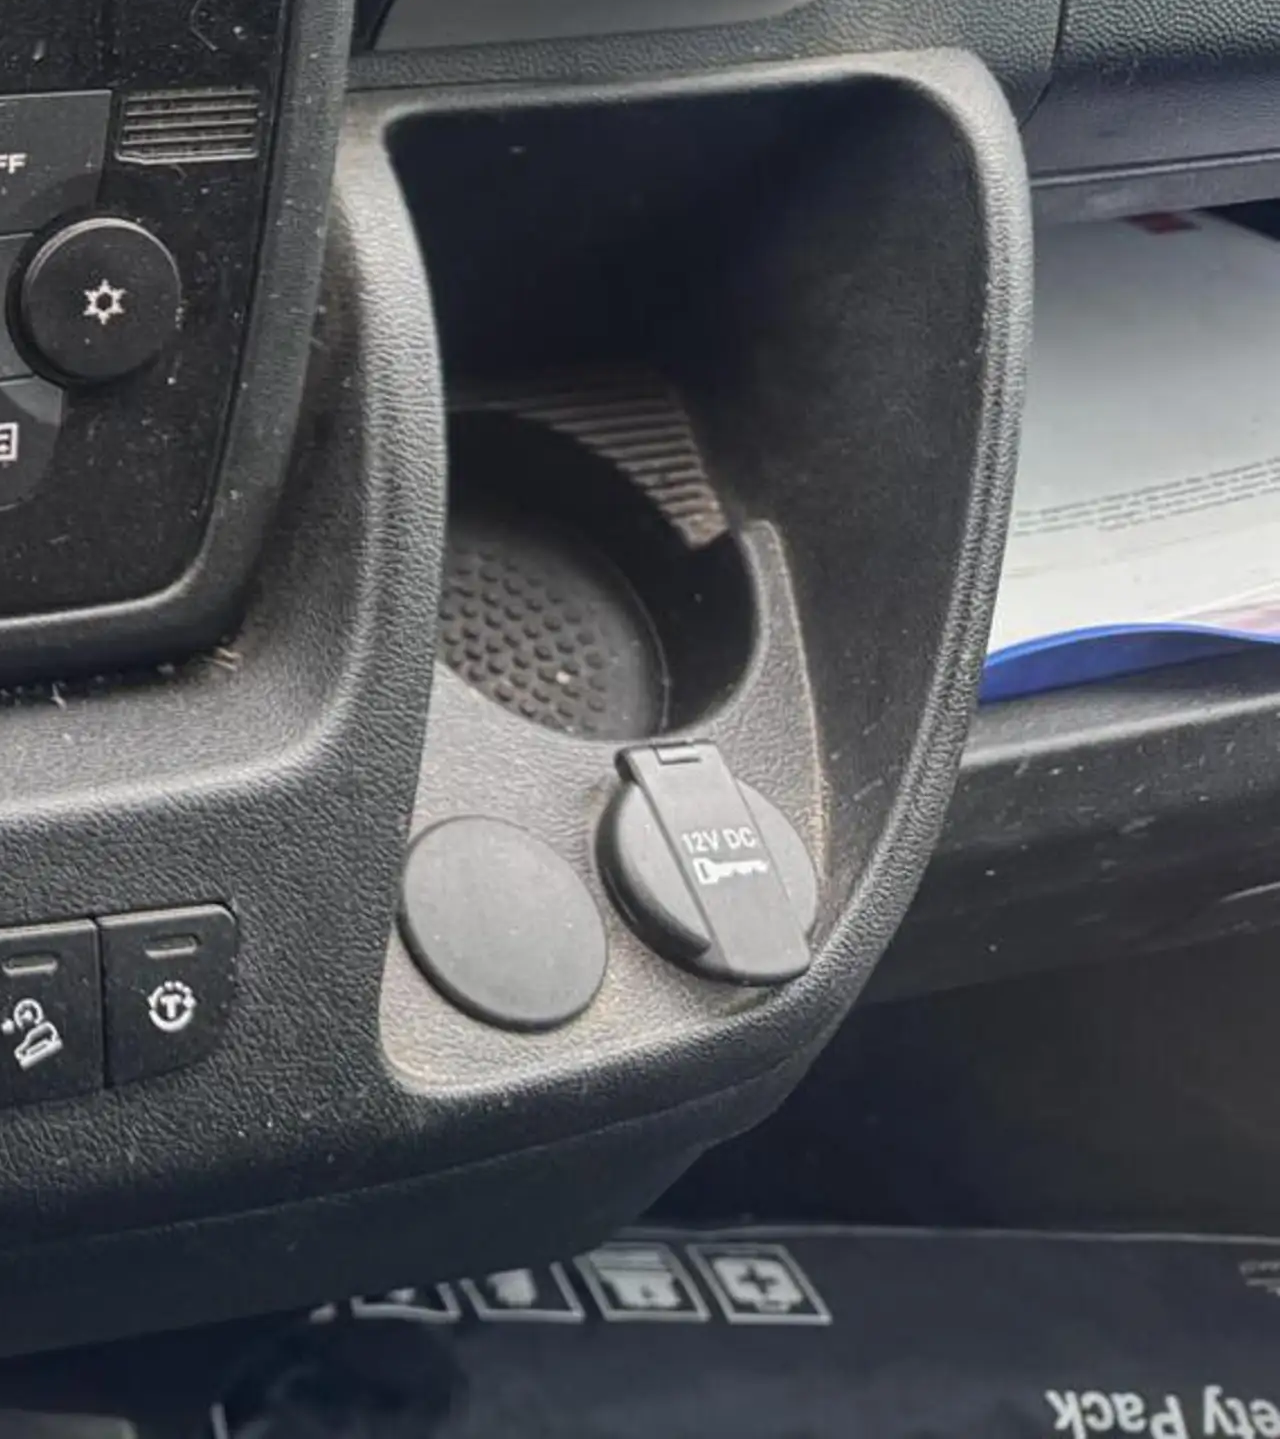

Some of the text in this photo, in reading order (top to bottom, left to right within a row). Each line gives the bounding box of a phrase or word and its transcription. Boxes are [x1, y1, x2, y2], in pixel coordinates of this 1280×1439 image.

[681, 825, 757, 855] 12V DC
[1045, 1389, 1190, 1439] Pack
